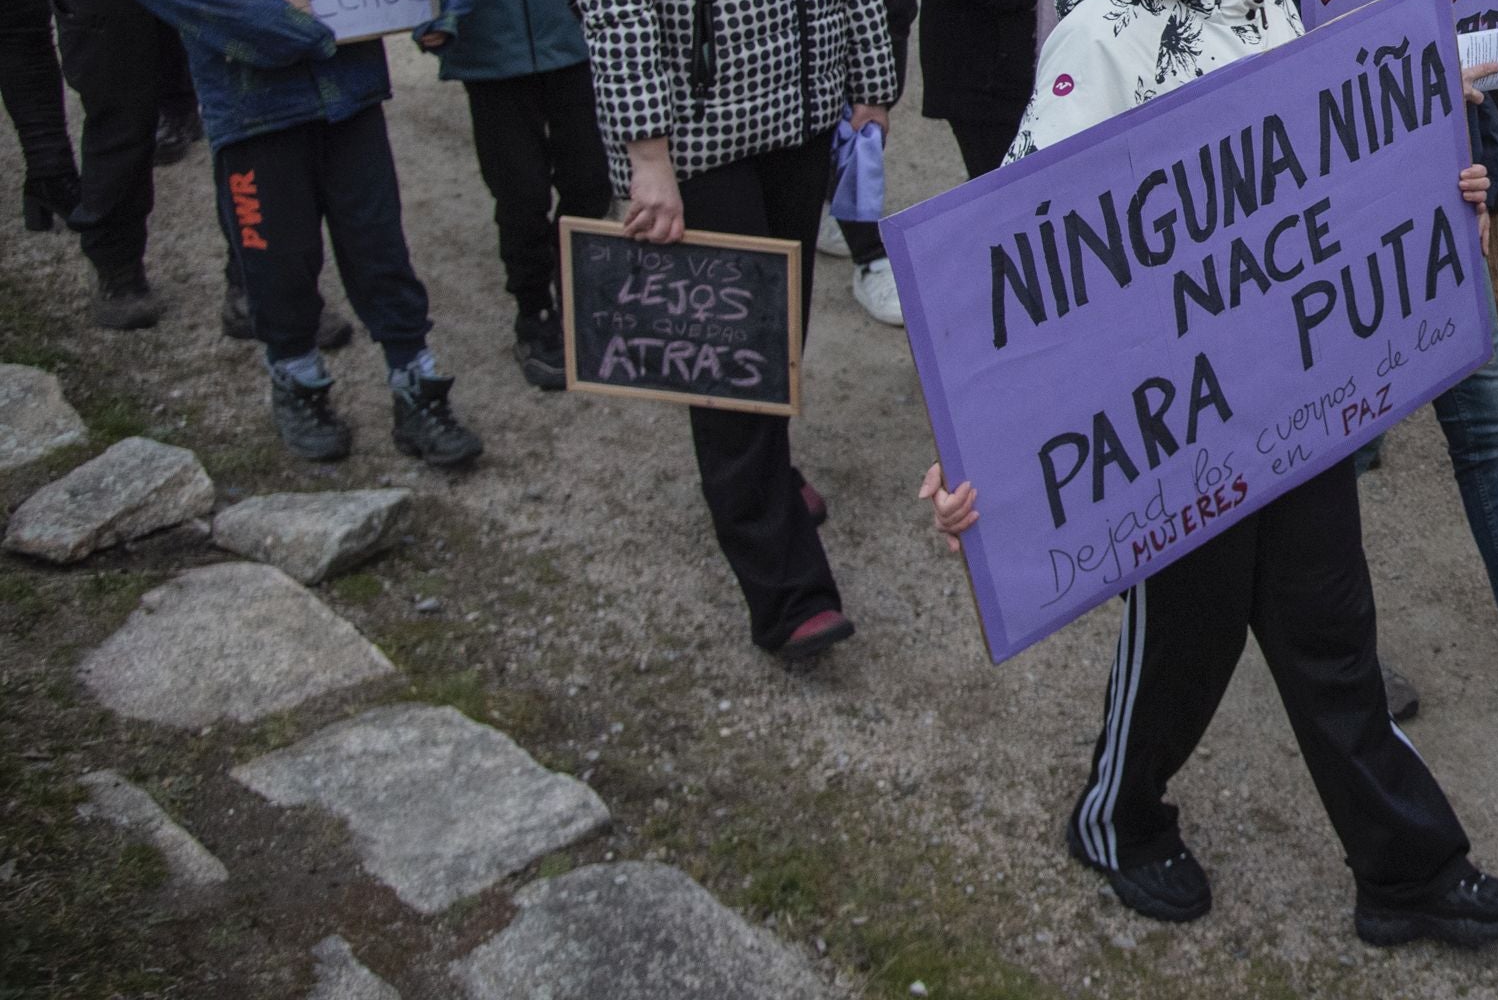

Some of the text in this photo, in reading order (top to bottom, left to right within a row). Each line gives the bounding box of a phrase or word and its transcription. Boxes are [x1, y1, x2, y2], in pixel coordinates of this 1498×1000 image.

[229, 169, 268, 250] PWR
[1173, 197, 1341, 338] NACE
[618, 272, 753, 322] LEJOS
[1038, 206, 1465, 530] PARA PUTA
[1041, 317, 1456, 608] Dejad los cuerpos de las
[1132, 382, 1393, 568] MUJERES en PAZ
